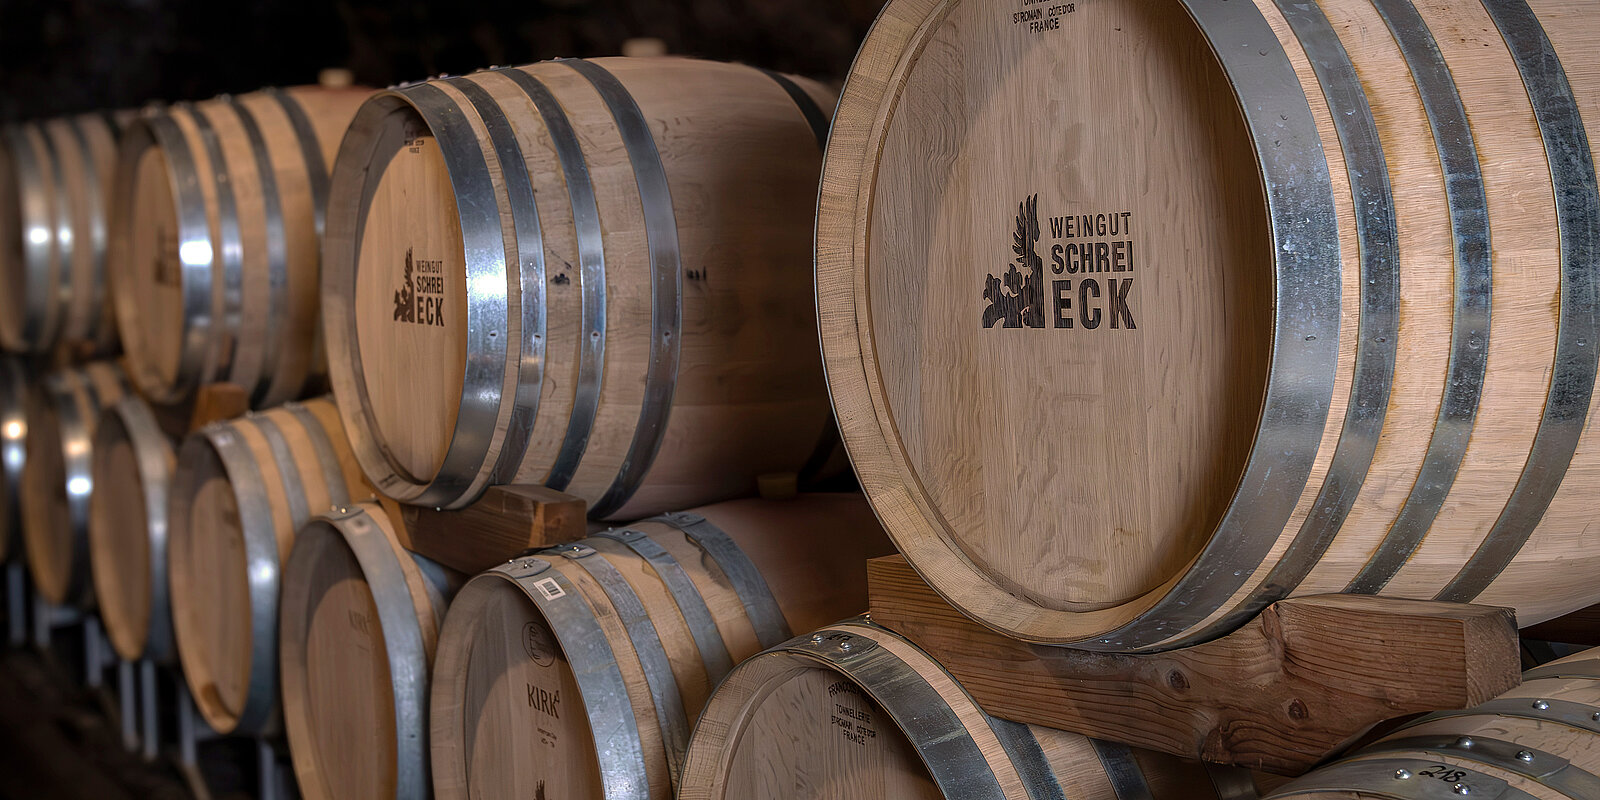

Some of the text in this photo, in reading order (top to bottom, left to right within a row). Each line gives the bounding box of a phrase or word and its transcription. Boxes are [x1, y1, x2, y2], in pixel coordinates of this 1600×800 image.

[1030, 18, 1060, 33] FRANCE
[1049, 212, 1131, 239] WEINGUT
[416, 260, 442, 273] WEINGUT
[1051, 241, 1133, 274] SCHREI
[416, 276, 444, 294] SCHREI
[417, 296, 444, 327] ECK
[1052, 278, 1136, 330] ECK
[844, 729, 866, 746] FRANCE
[1418, 765, 1467, 783] 218
